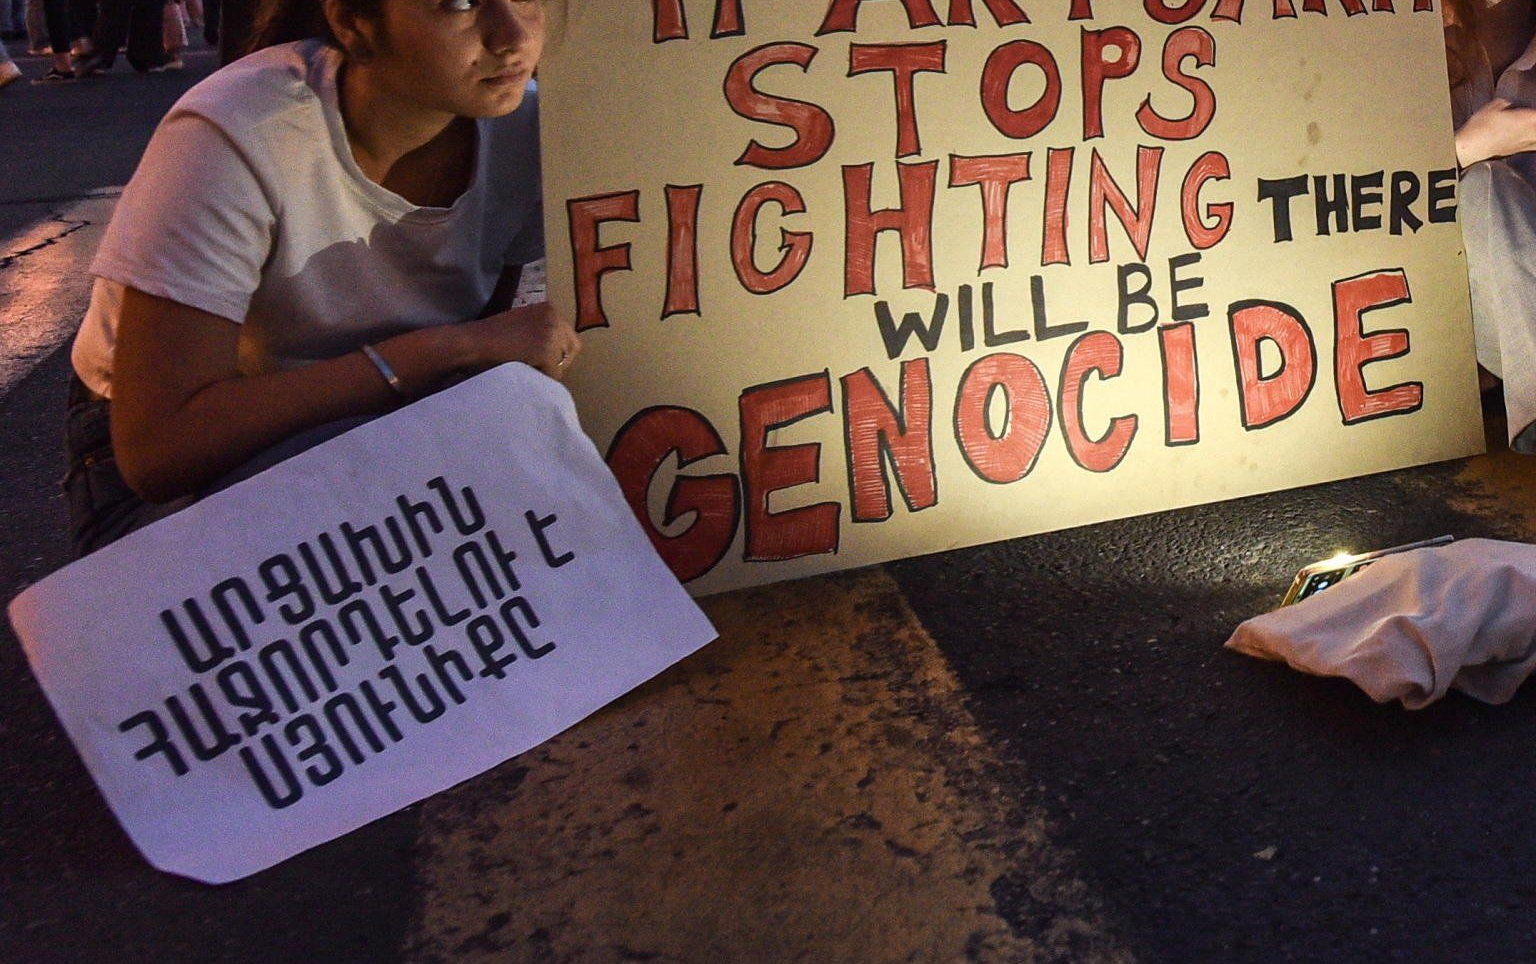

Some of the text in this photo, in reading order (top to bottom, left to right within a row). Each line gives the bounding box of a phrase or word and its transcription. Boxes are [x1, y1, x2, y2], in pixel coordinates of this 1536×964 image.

[723, 24, 1217, 170] STOPS
[566, 146, 1457, 333] FIGHTING THERE
[874, 252, 1210, 359] WILL BE
[606, 268, 1424, 584] GENOCIDE
[160, 475, 487, 675] ԱՐՑԱԽԻՆ
